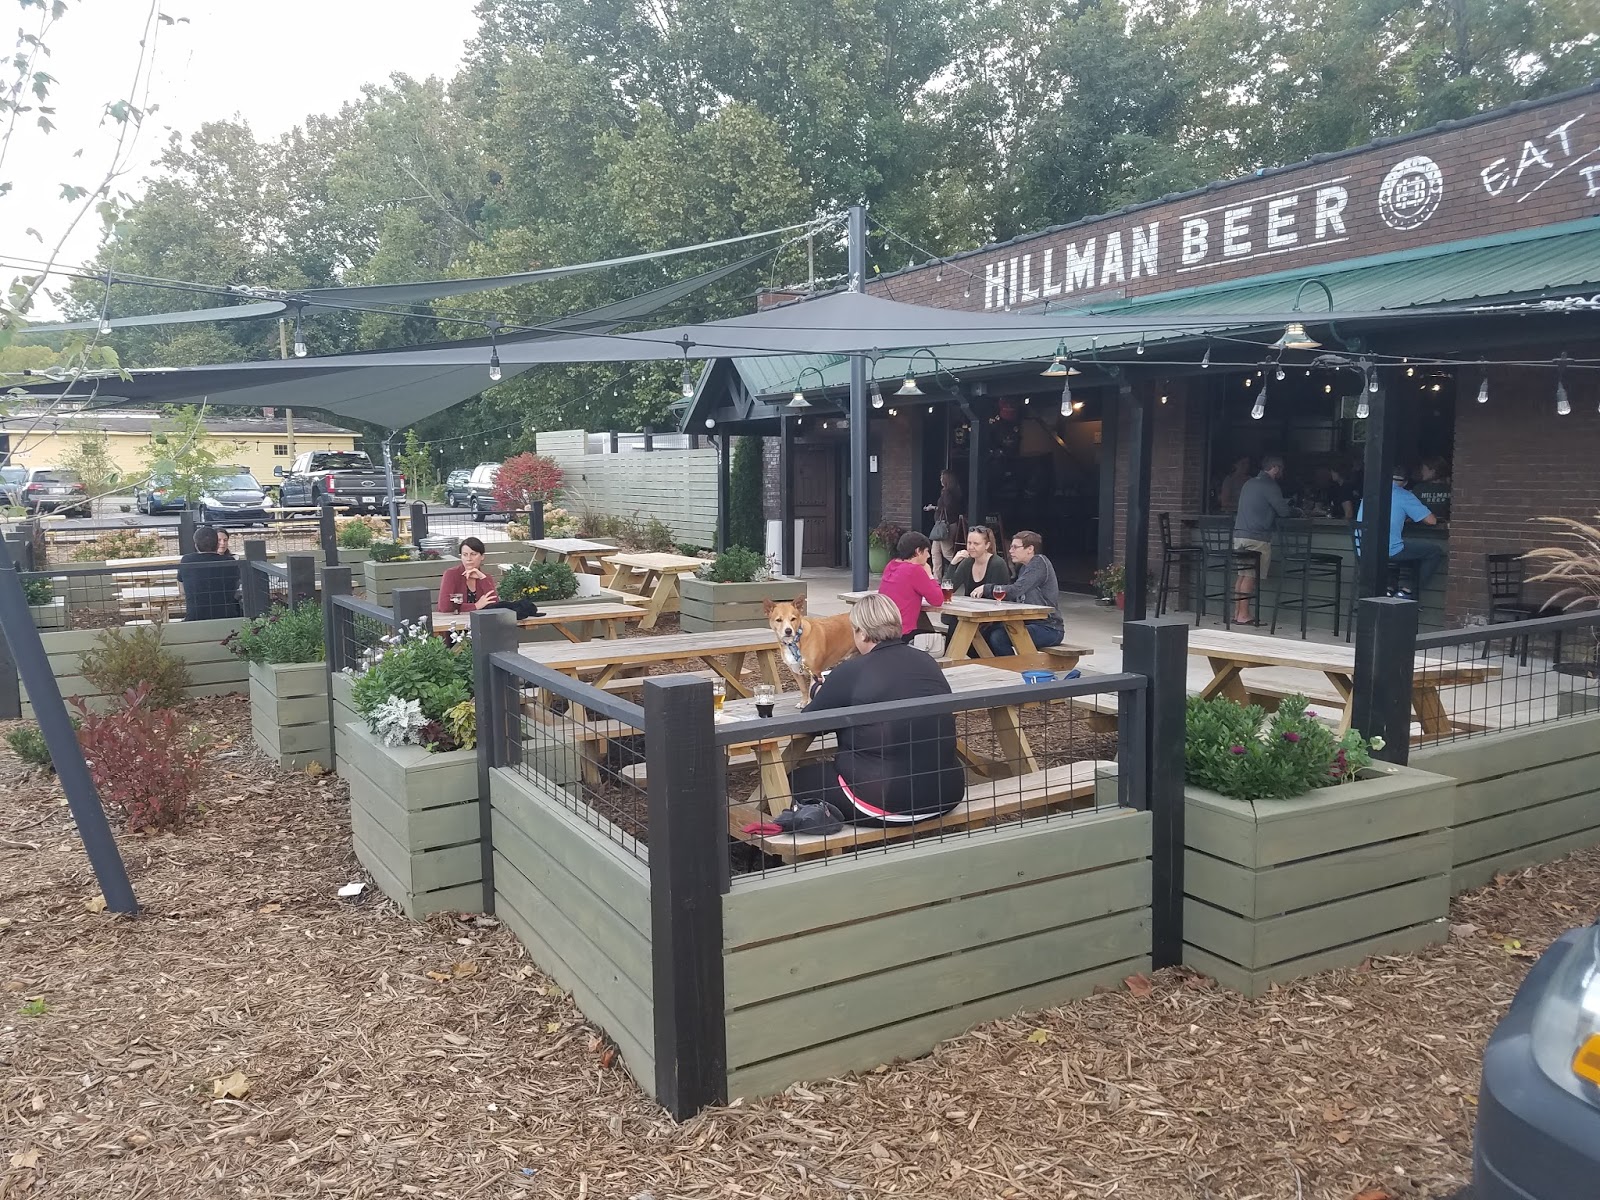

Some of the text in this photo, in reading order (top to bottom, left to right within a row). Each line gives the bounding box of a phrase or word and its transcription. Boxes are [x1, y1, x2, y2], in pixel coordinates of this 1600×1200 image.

[1480, 113, 1586, 196] EAT
[984, 221, 1160, 311] HILLMAN
[1181, 186, 1350, 266] BEER
